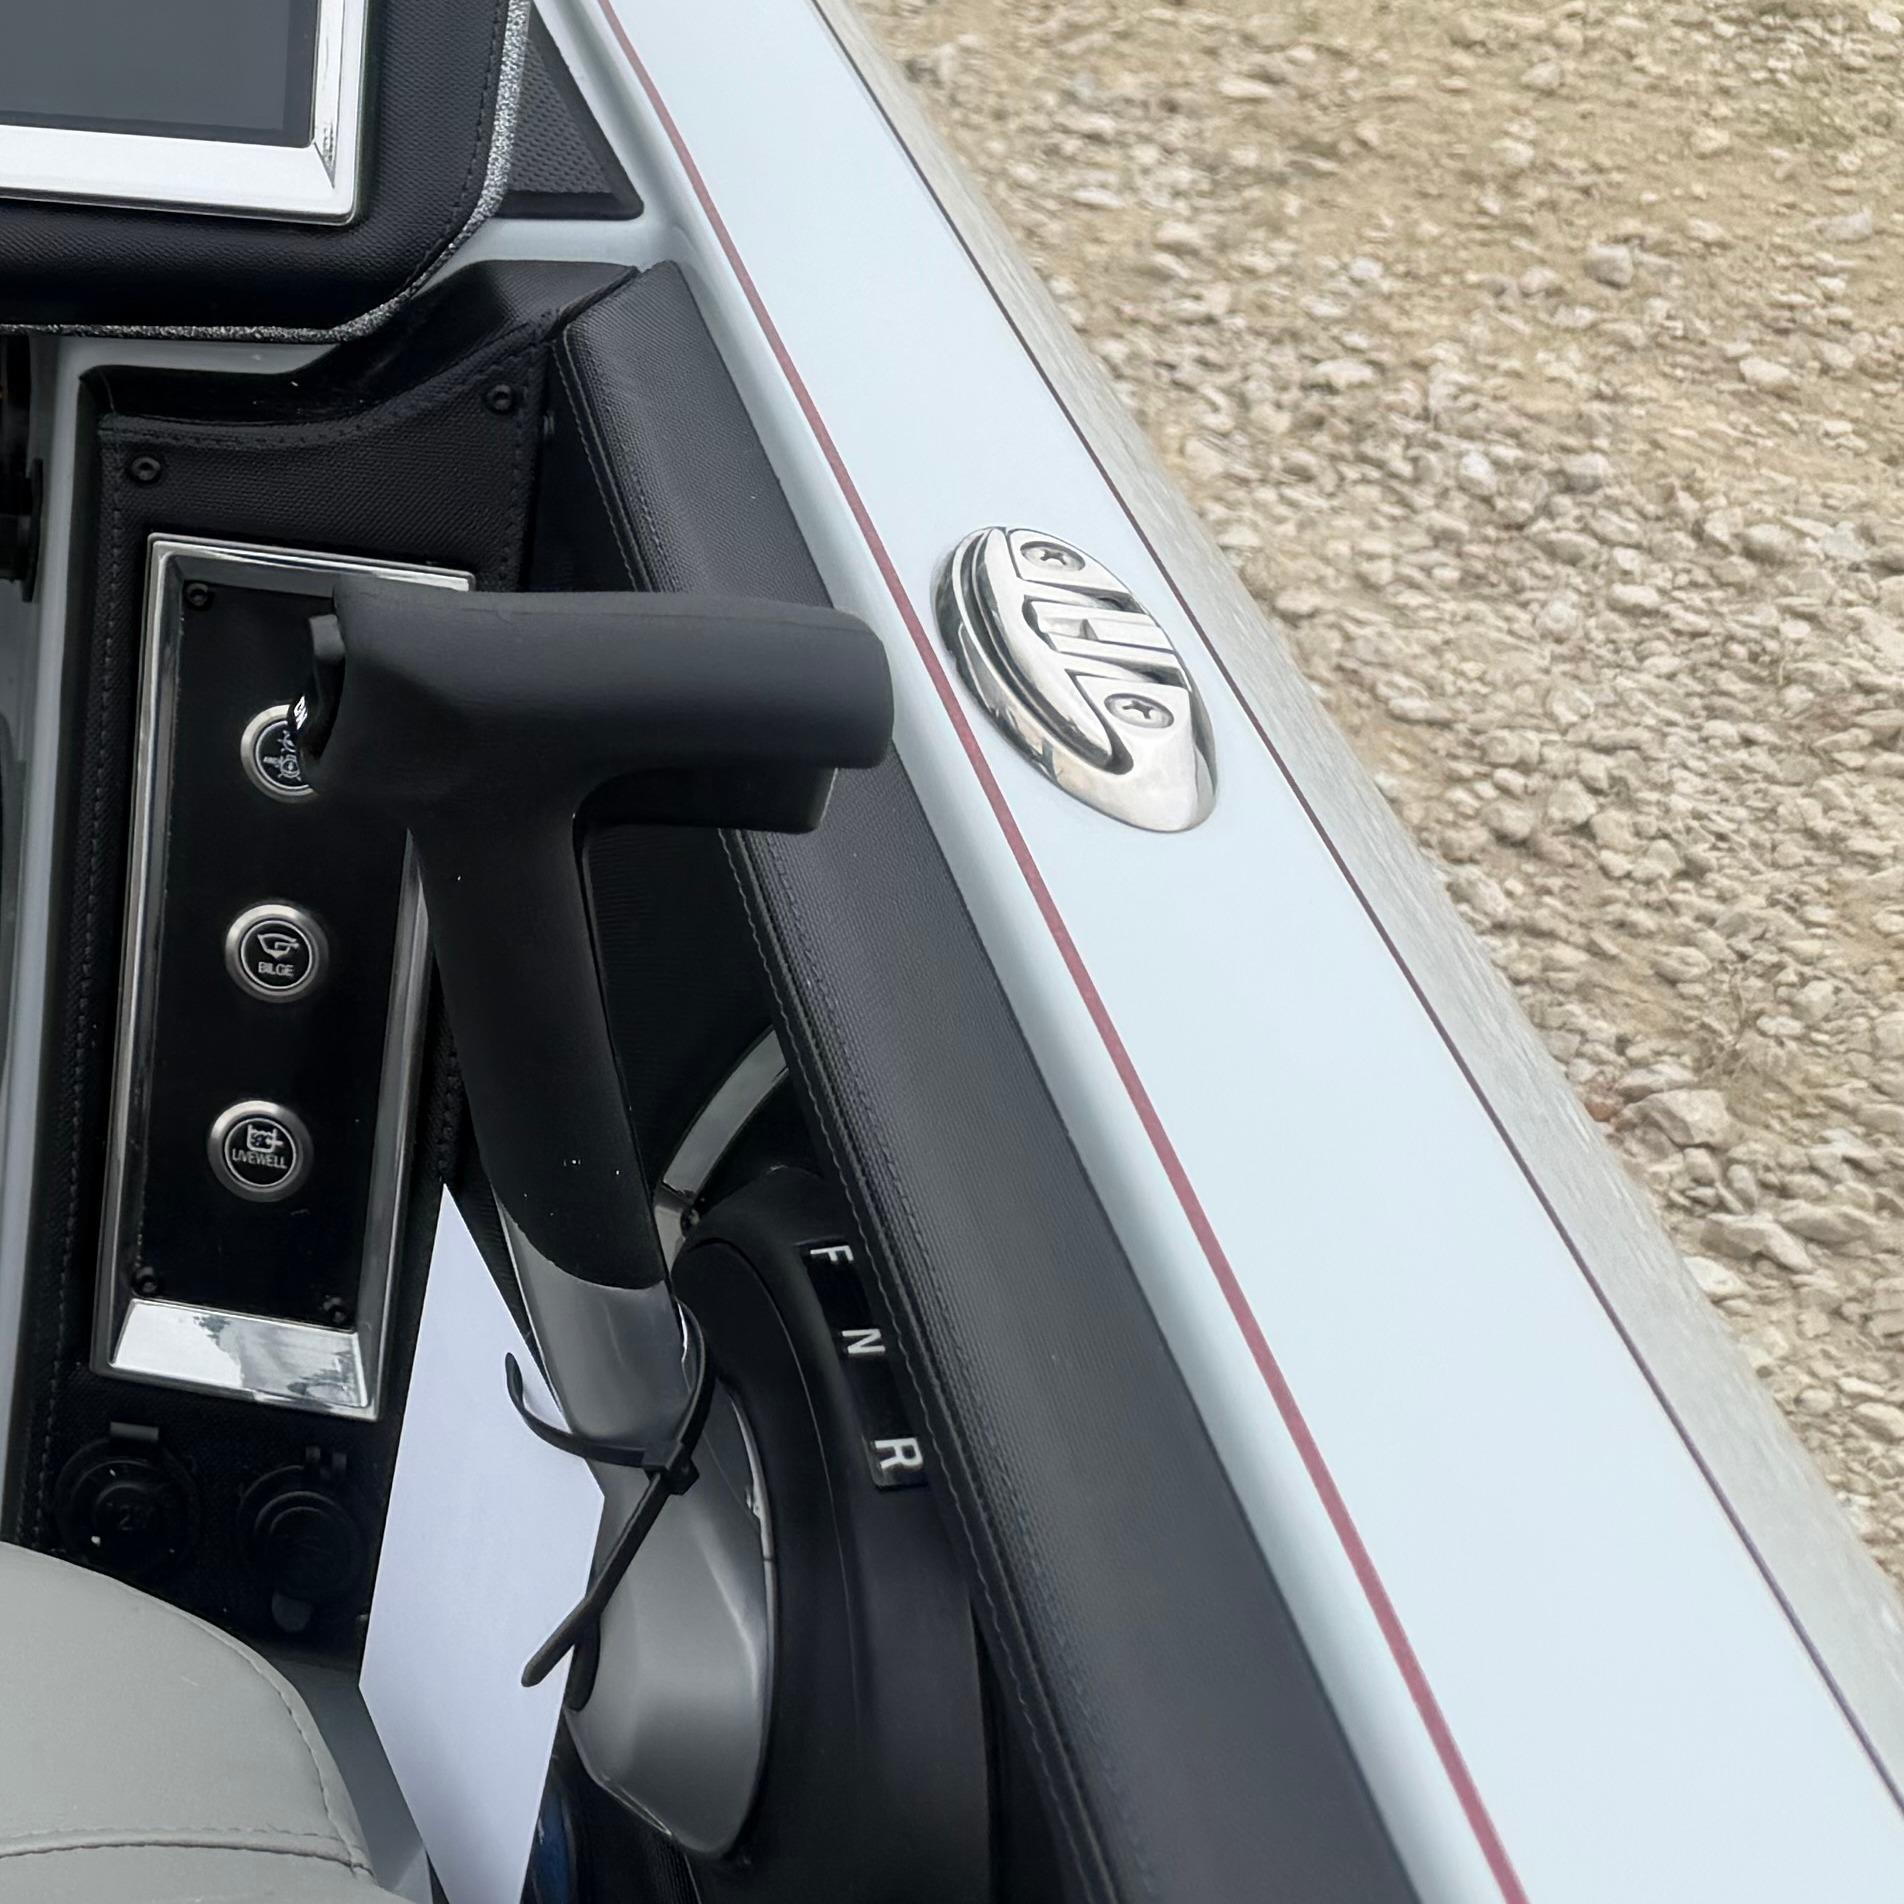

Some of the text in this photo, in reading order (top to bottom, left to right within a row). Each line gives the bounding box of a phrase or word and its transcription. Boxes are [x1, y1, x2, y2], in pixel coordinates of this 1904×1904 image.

[258, 961, 295, 978] BILGE
[232, 1148, 288, 1170] LIVEWELL
[810, 1245, 854, 1262] F
[842, 1328, 886, 1354] N
[874, 1437, 923, 1470] R
